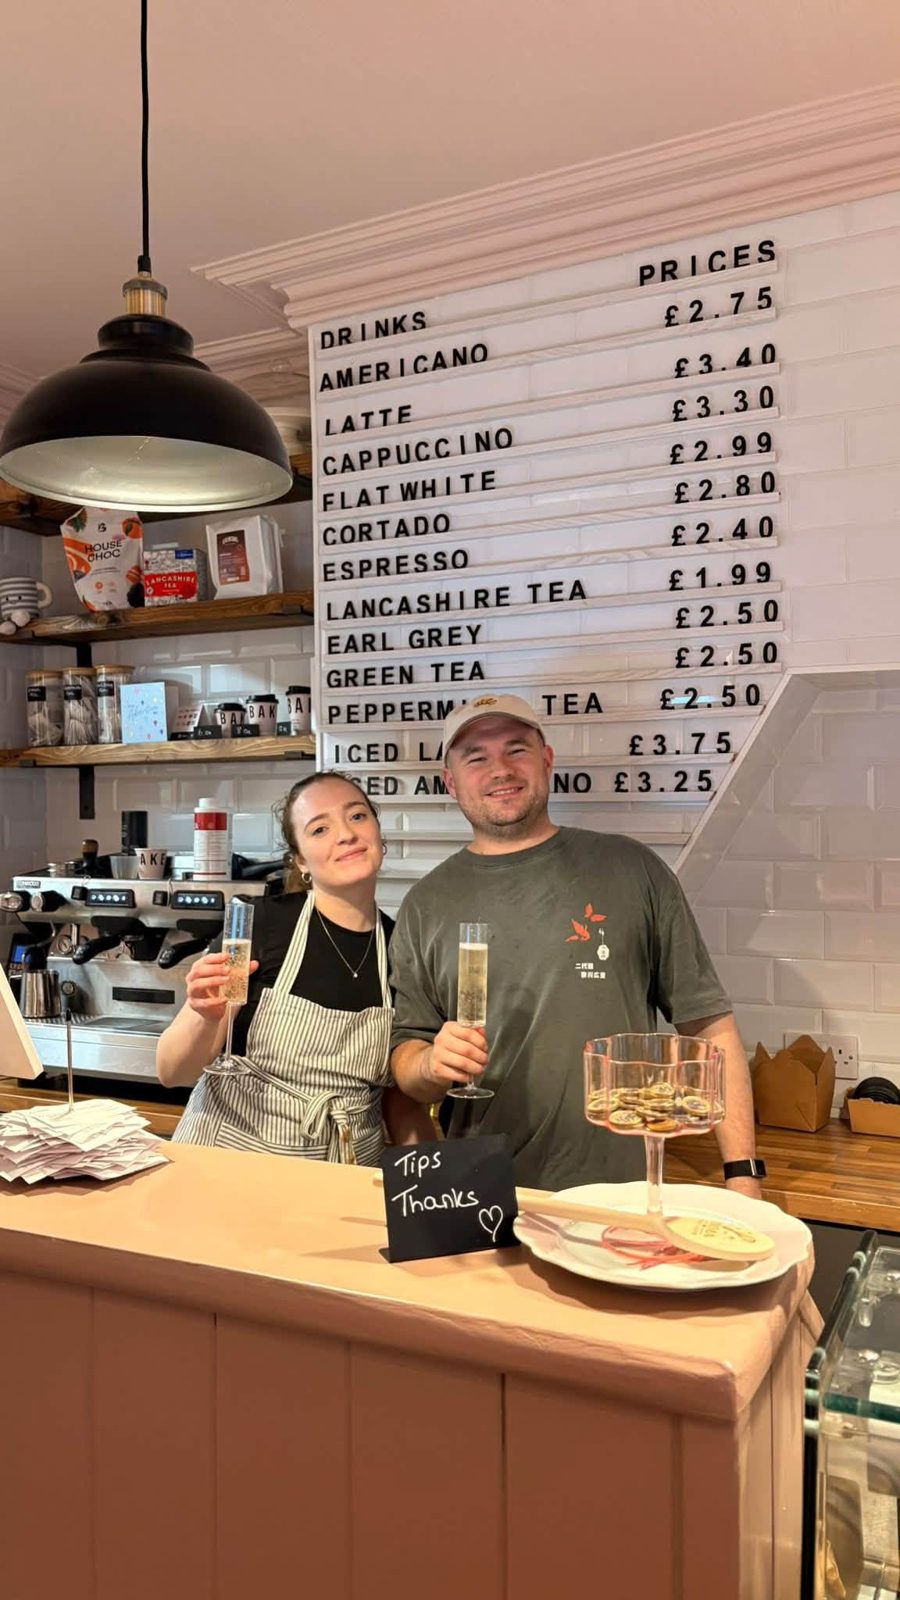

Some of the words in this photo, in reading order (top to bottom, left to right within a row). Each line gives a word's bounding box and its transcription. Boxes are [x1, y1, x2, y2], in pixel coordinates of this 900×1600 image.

[639, 239, 776, 287] PRICES
[664, 286, 773, 328] £2.75
[320, 311, 427, 350] DRINKS
[319, 343, 488, 392] AMERICANO
[674, 343, 776, 379] £3.40
[325, 404, 412, 436] LATTE
[672, 385, 774, 423] £3.30
[322, 427, 513, 476] CAPPUCCINO
[669, 431, 772, 466] £2.99
[322, 485, 390, 512] FLAT
[399, 470, 496, 502] WHITE
[674, 471, 776, 505] £2.80
[322, 513, 450, 546] CORTADO
[671, 515, 774, 547] £2.40
[85, 540, 122, 554] HOUSE
[88, 549, 121, 562] CHOC
[322, 549, 469, 582] ESPRESSO
[668, 561, 771, 592] £1.99
[326, 586, 511, 621] LANCASHIRE
[527, 579, 587, 605] TEA
[675, 599, 779, 630] £2.50
[327, 631, 395, 655] EARL
[408, 624, 482, 650] GREY
[675, 641, 778, 669] £2.50
[326, 664, 414, 689] GREEN
[430, 660, 486, 683] TEA
[328, 699, 467, 726] PEPPERM
[541, 692, 604, 716] TEA
[659, 683, 761, 711] £2.50
[335, 742, 399, 764] ICED
[628, 731, 731, 757] £3.75
[613, 769, 712, 793] £3.25
[394, 1150, 441, 1178] Tips
[391, 1184, 479, 1217] Thanks
